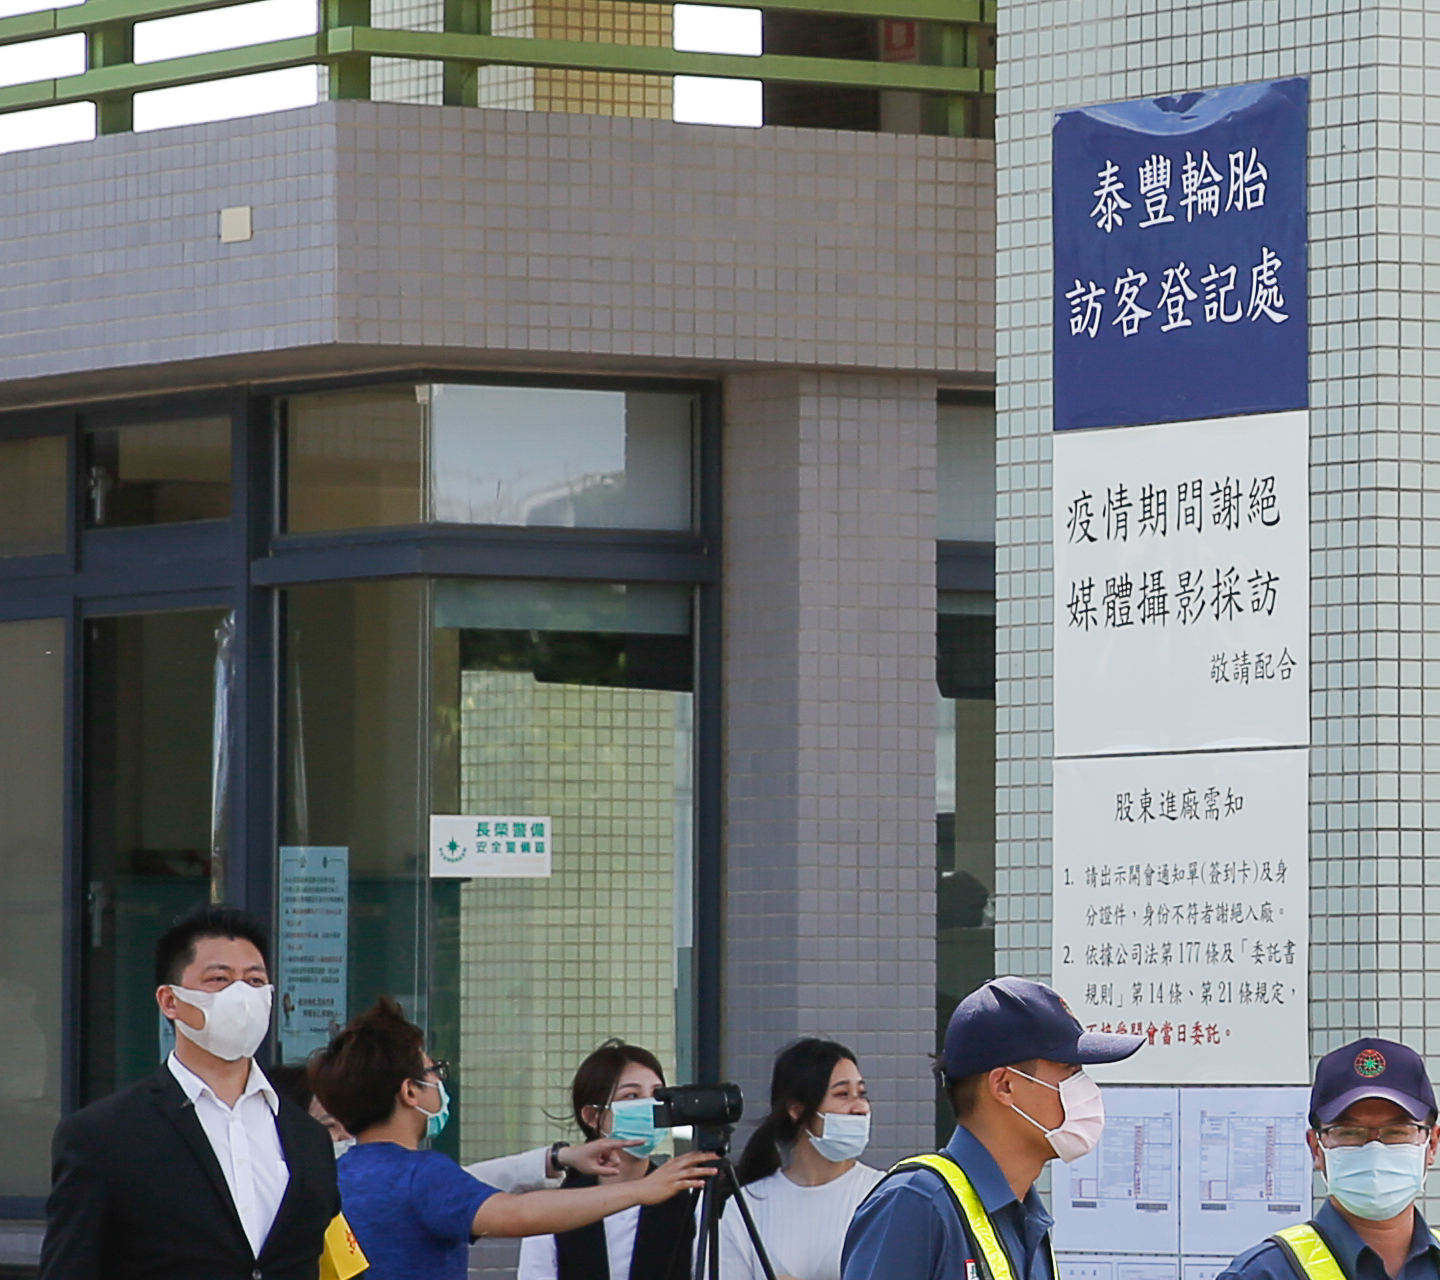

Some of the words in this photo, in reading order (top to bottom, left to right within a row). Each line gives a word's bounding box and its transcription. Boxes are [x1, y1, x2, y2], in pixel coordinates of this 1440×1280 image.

[1090, 147, 1269, 233] 泰豐輪胎
[1065, 247, 1289, 338] 訪客登記處
[1066, 475, 1281, 544] 疫情期間謝絕
[1066, 566, 1280, 632] 媒體攝影採訪
[1210, 647, 1297, 685] 敬請配合
[1114, 787, 1244, 823] 股東進廠需知
